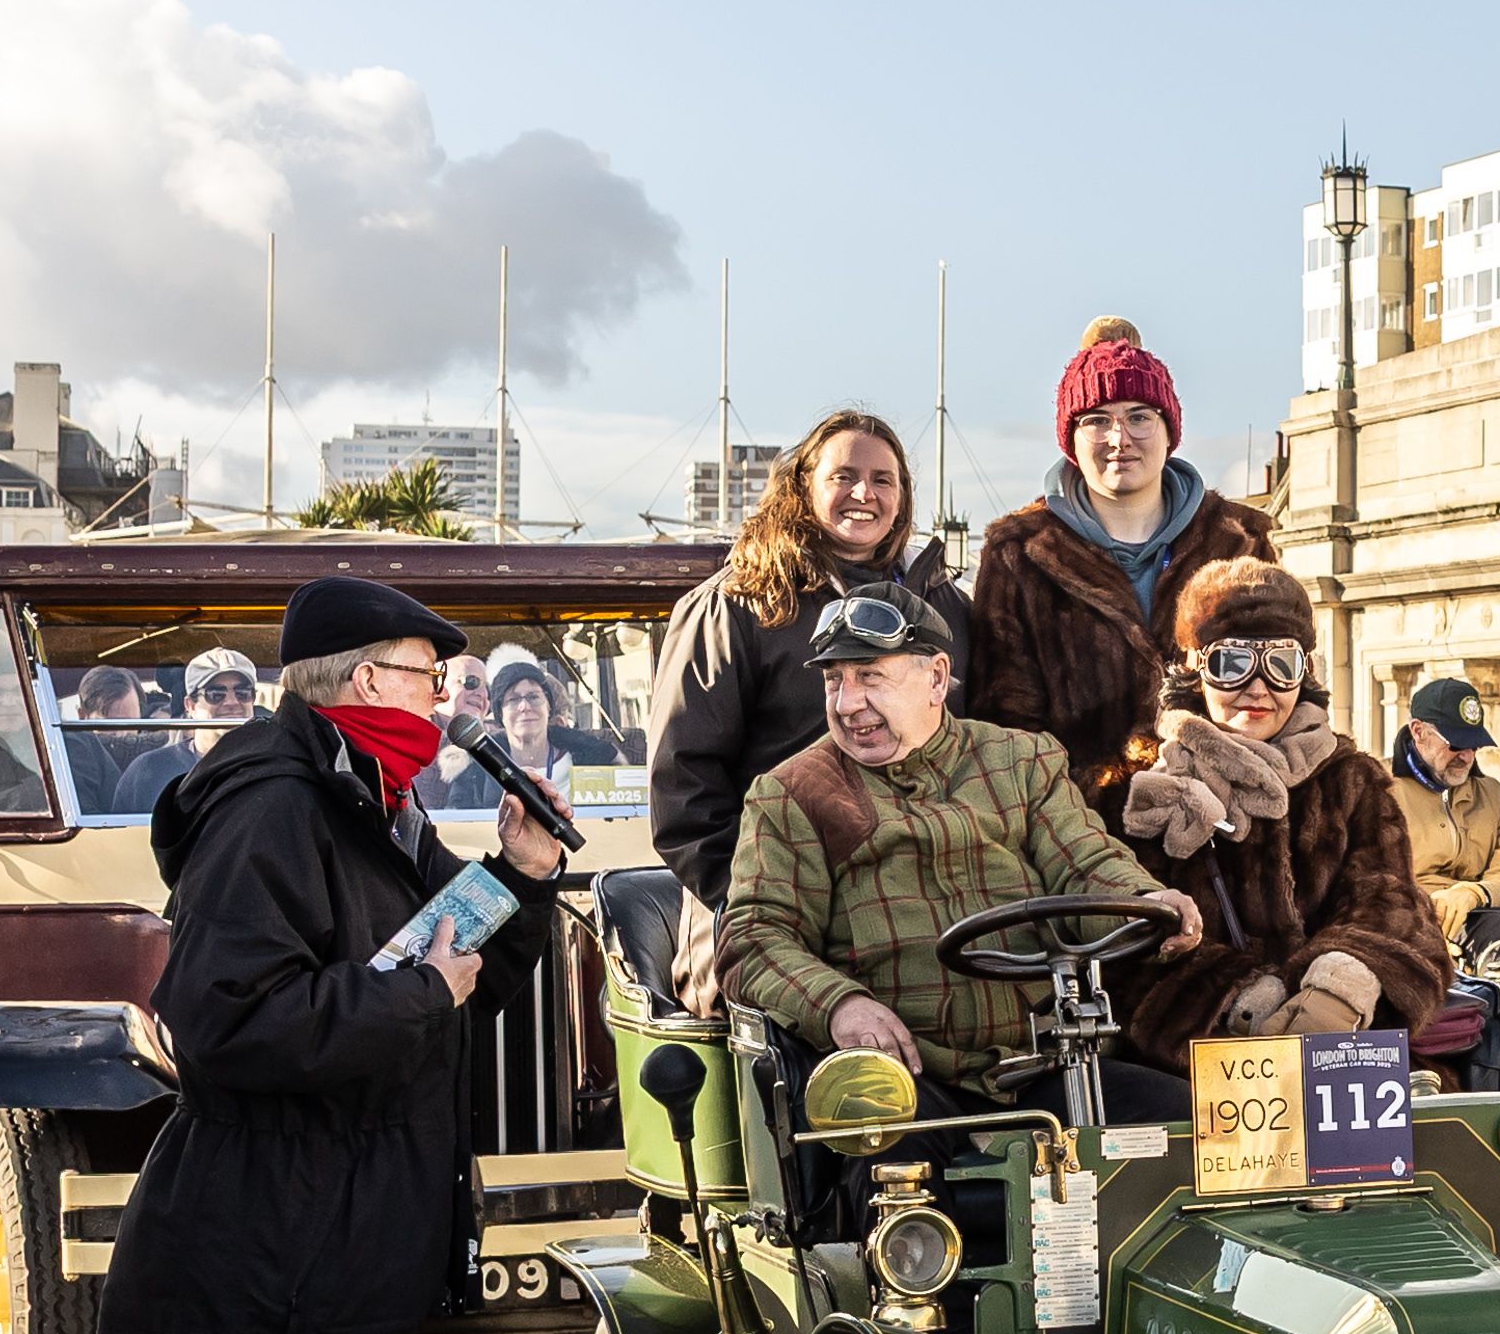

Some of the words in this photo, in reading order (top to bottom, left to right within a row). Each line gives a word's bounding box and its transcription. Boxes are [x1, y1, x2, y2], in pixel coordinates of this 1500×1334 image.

[608, 790, 641, 803] 2025
[1312, 1050, 1346, 1067] LONDON
[1346, 1049, 1357, 1061] TO
[1359, 1047, 1400, 1063] BRIGHTON
[1221, 1058, 1278, 1080] V.C.C.
[1210, 1098, 1290, 1133] 1902
[1315, 1080, 1406, 1132] 112
[1204, 1152, 1300, 1173] DELAHAYE
